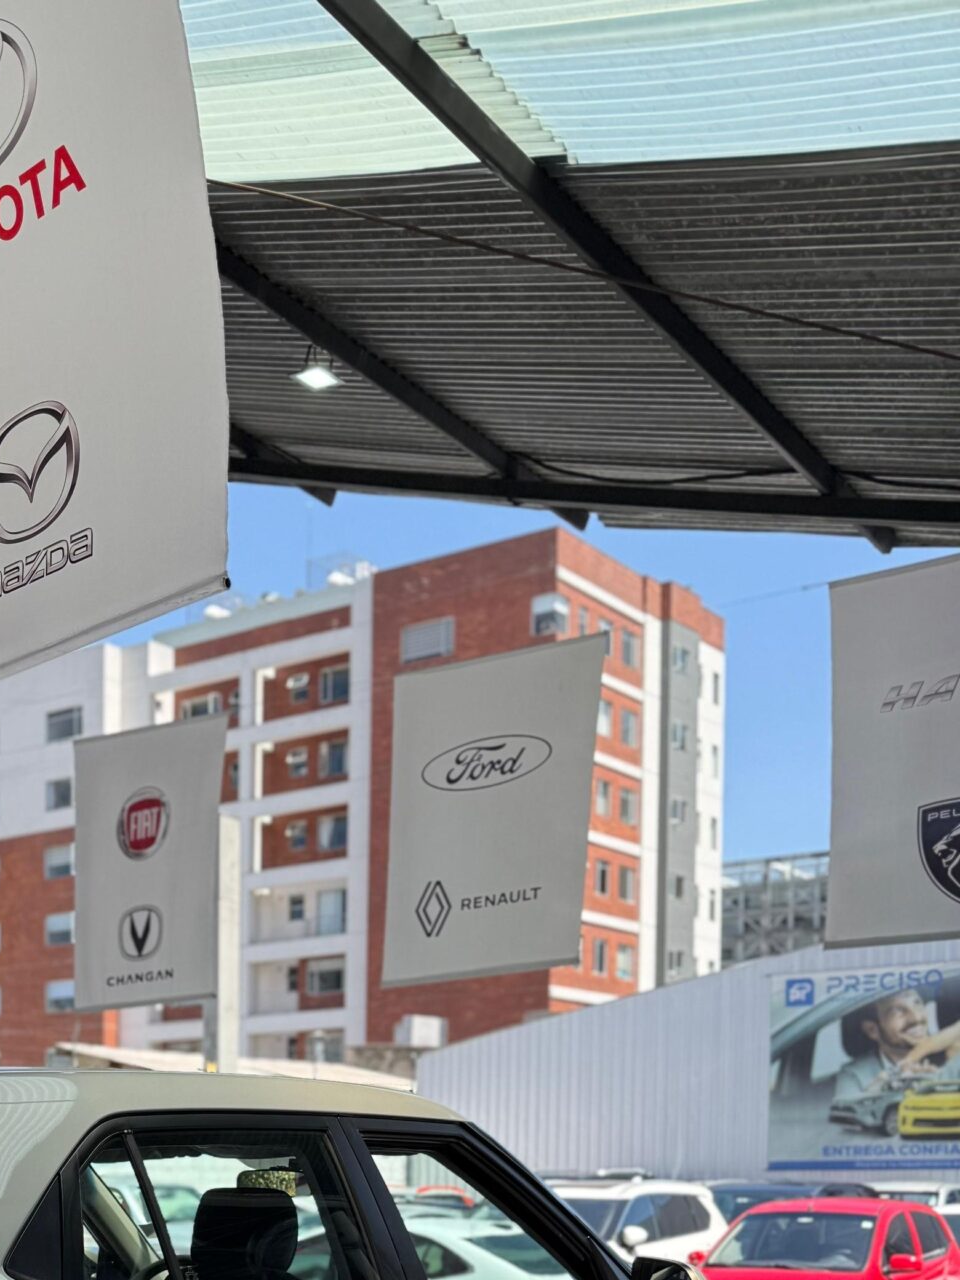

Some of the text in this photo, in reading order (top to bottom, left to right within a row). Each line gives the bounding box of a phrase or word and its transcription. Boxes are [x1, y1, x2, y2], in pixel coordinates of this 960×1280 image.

[446, 742, 526, 785] Ford
[129, 806, 160, 842] FIAT
[460, 887, 542, 911] RENAULT
[106, 968, 174, 987] CHANGAN
[826, 969, 943, 994] PRECISO
[821, 1145, 896, 1157] ENTREGA
